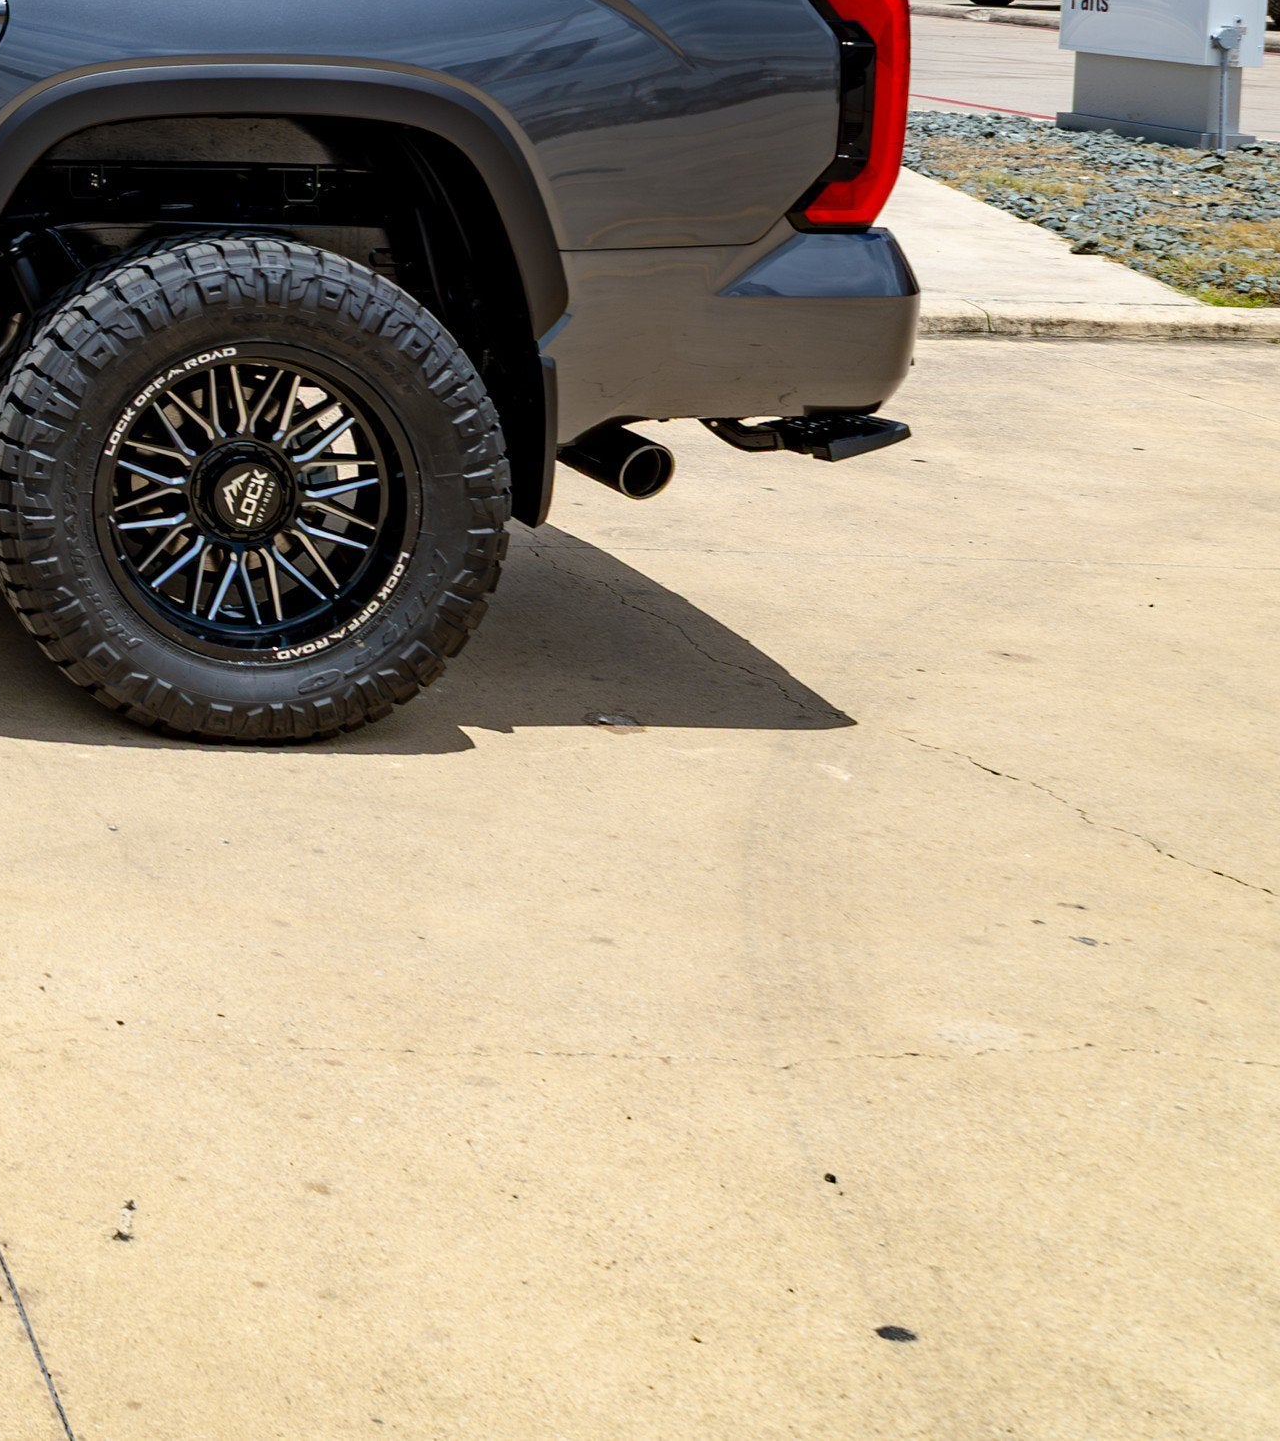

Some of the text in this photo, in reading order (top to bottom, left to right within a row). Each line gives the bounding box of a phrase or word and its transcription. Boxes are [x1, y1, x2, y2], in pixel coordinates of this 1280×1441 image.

[104, 347, 237, 457] LOCK OFF ROAD
[235, 469, 269, 527] LOCK
[276, 551, 410, 660] LOCK OFF ROAD
